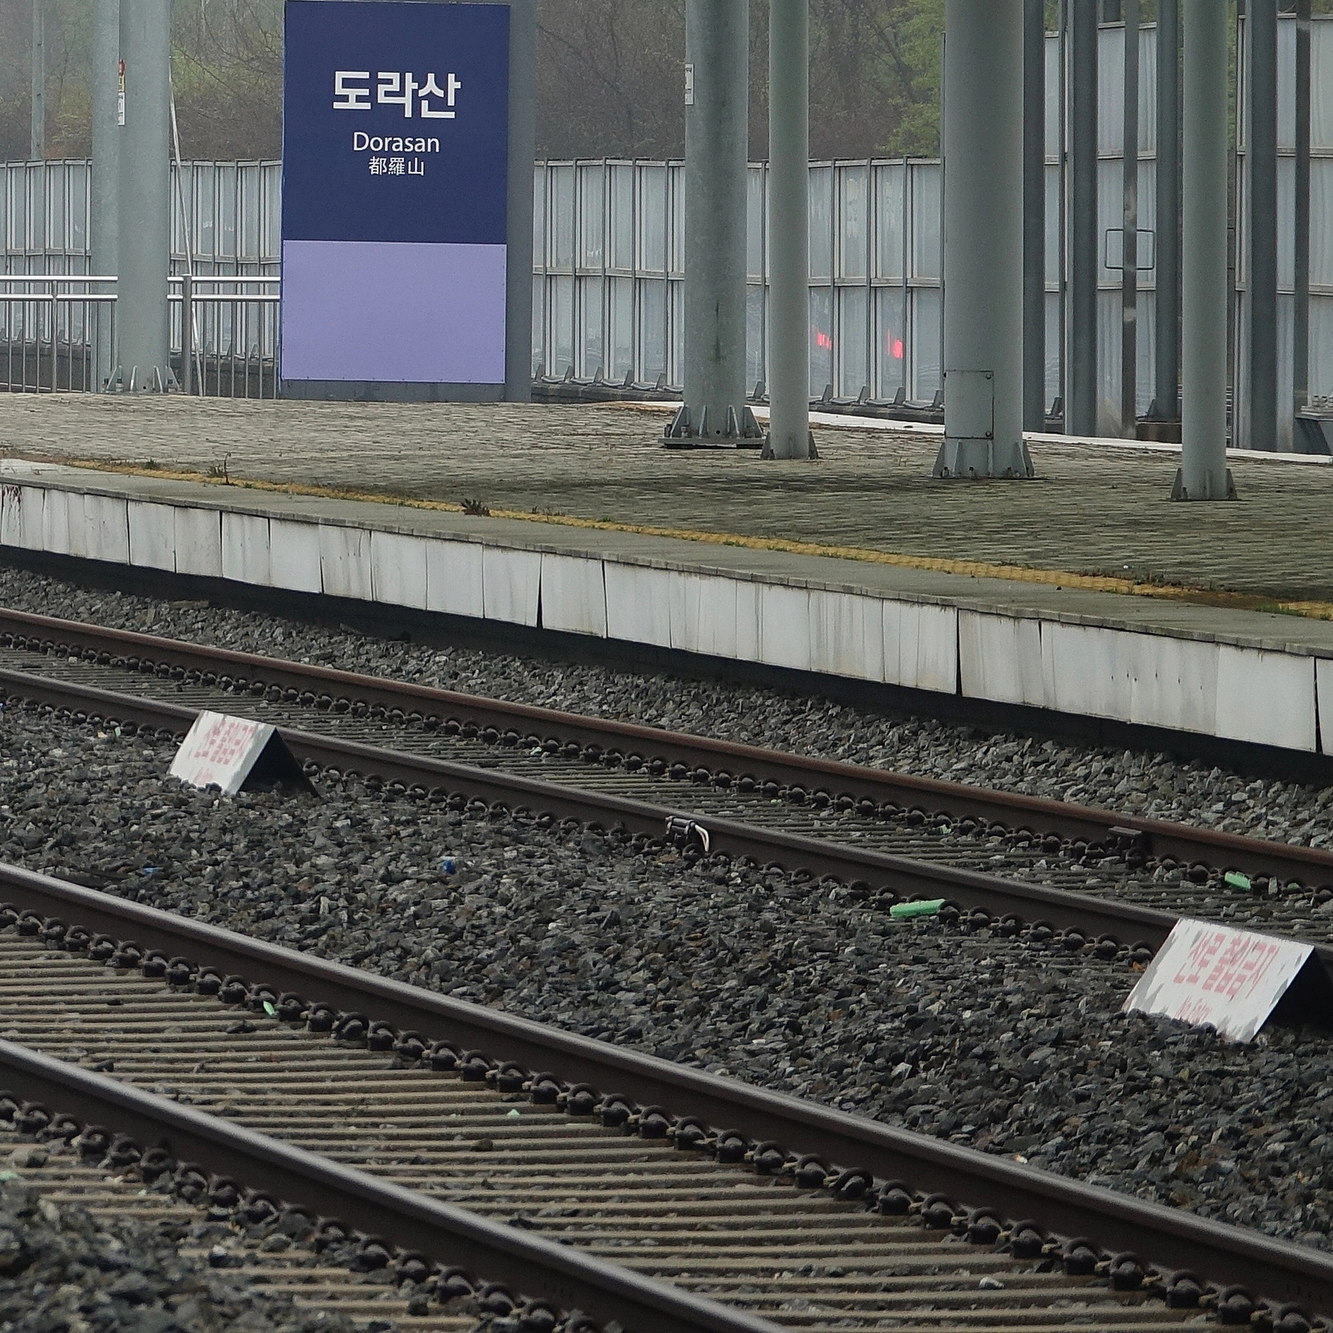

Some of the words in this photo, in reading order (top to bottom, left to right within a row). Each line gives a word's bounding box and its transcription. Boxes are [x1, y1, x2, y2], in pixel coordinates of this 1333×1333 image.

[332, 70, 462, 119] 도라산
[353, 131, 440, 153] Dorasan
[368, 156, 425, 176] 都羅山
[1173, 930, 1227, 984] 선로
[1201, 933, 1280, 1000] 출입금지
